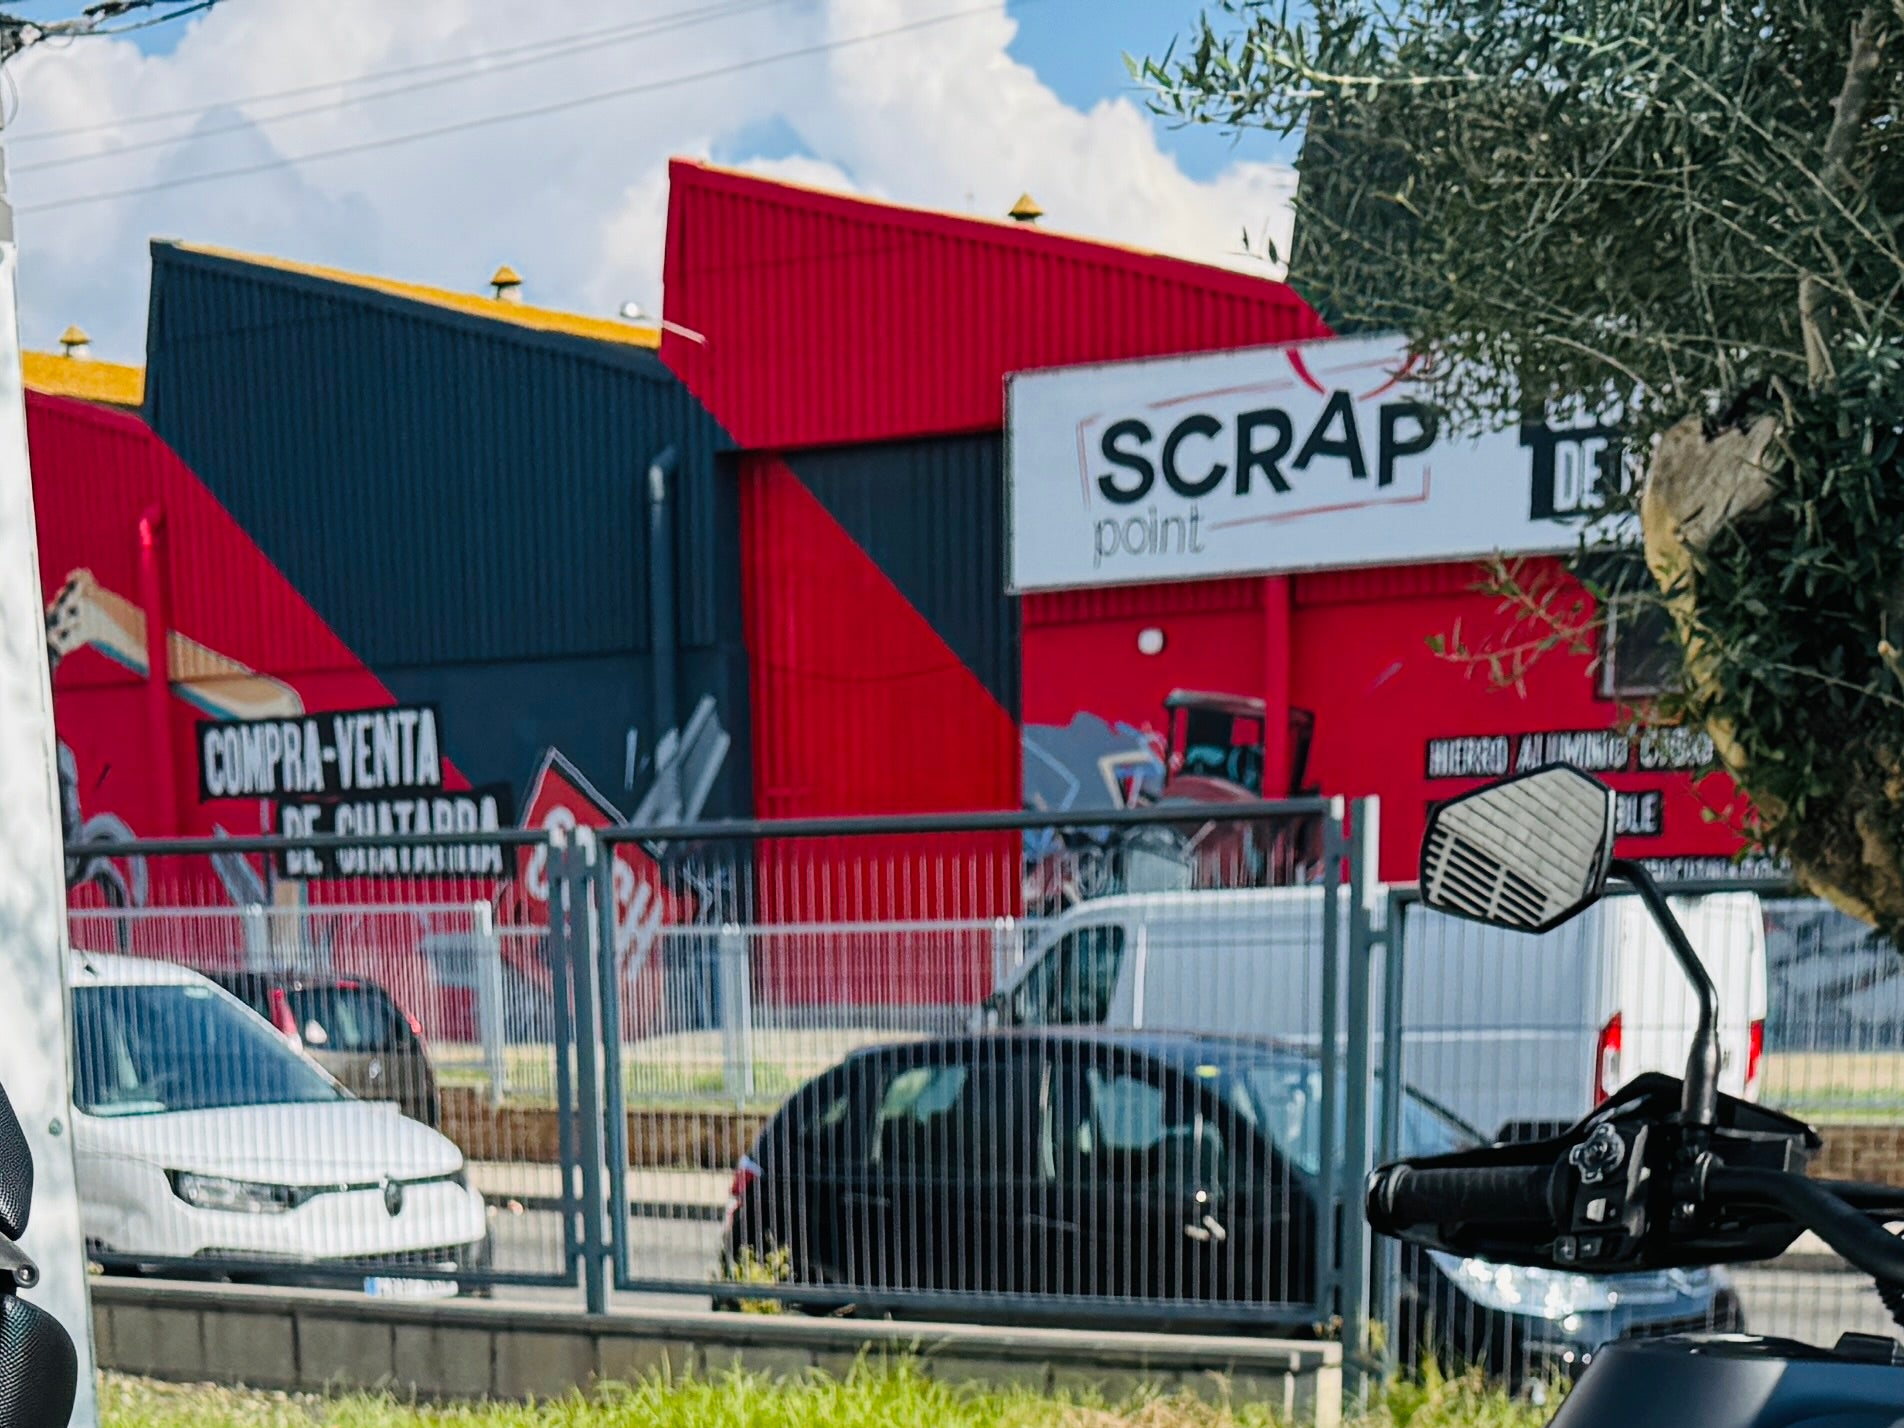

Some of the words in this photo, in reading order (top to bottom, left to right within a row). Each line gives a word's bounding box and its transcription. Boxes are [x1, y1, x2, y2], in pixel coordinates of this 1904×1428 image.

[1098, 389, 1439, 504] SCRAP
[1093, 507, 1204, 569] point
[204, 708, 440, 796] COMPRA-VENTA
[282, 804, 324, 875] DE
